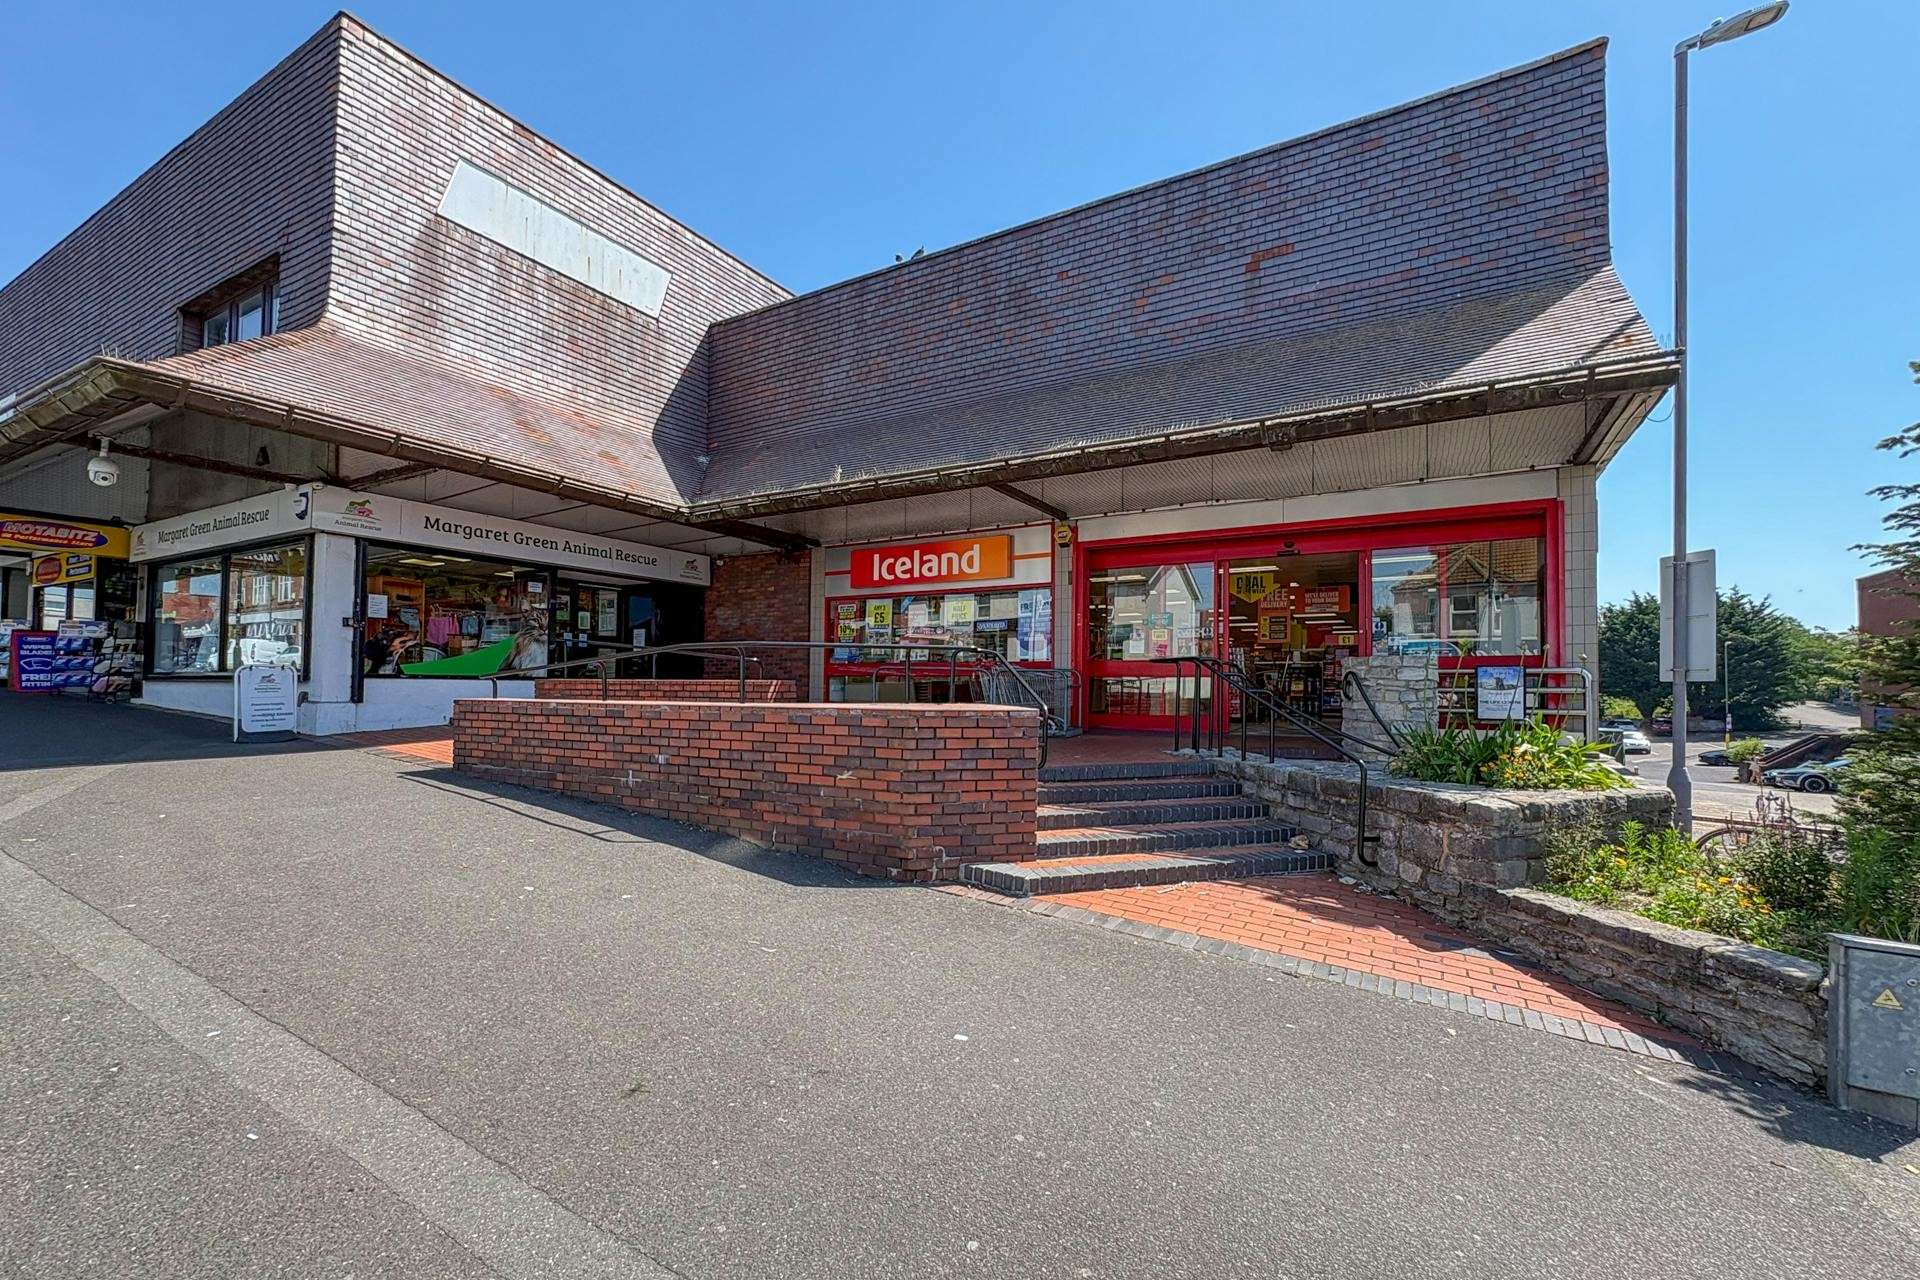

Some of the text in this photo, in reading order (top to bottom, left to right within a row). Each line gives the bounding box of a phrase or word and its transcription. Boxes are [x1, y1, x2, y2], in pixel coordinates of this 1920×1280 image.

[3, 522, 99, 542] MOTABITZ
[157, 508, 270, 545] Margaret Green Animal Rescue
[334, 519, 359, 529] Animal
[423, 515, 658, 567] Margaret Green Animal Rescue
[873, 544, 980, 581] Iceland
[1236, 576, 1265, 590] DAL
[874, 612, 885, 624] £5
[21, 673, 51, 681] FRE
